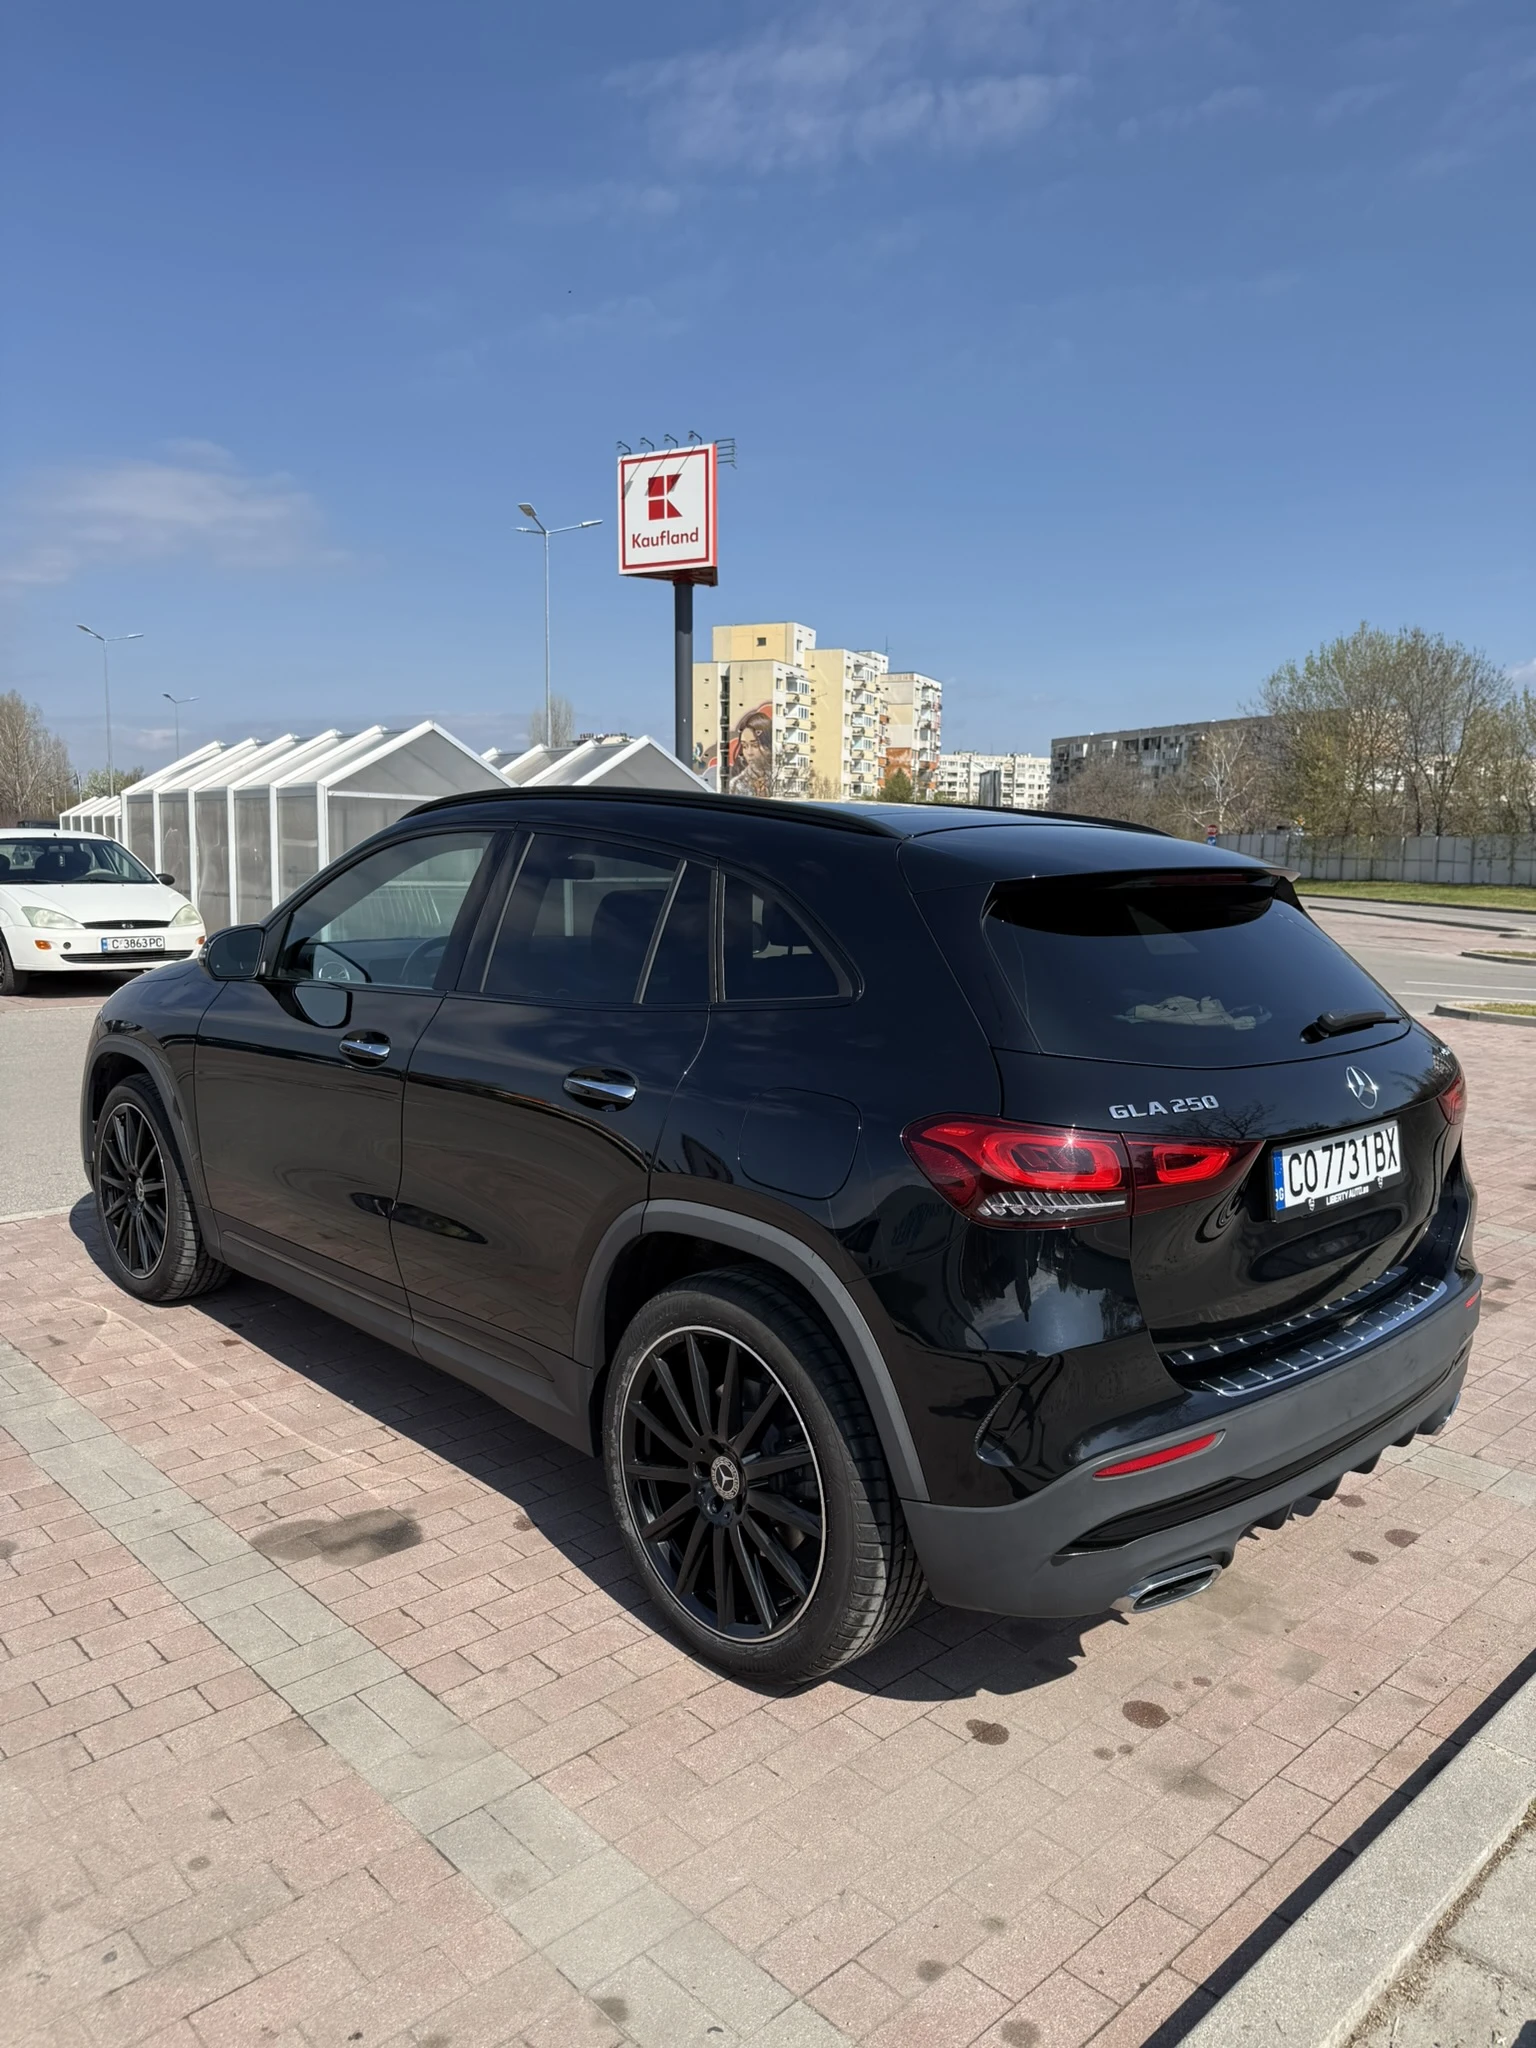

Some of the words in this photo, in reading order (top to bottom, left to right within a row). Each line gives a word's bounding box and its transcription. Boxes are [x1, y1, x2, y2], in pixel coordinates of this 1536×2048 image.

[648, 473, 683, 521] K
[632, 526, 699, 549] Kaufland
[112, 939, 119, 949] C
[124, 938, 148, 948] 3863
[149, 938, 163, 947] PC
[1108, 1100, 1168, 1120] GLA
[1170, 1094, 1220, 1114] 250
[1288, 1151, 1319, 1198] CO
[1322, 1135, 1371, 1190] 7731
[1374, 1127, 1399, 1173] BX
[1325, 1190, 1349, 1206] LIBERTY
